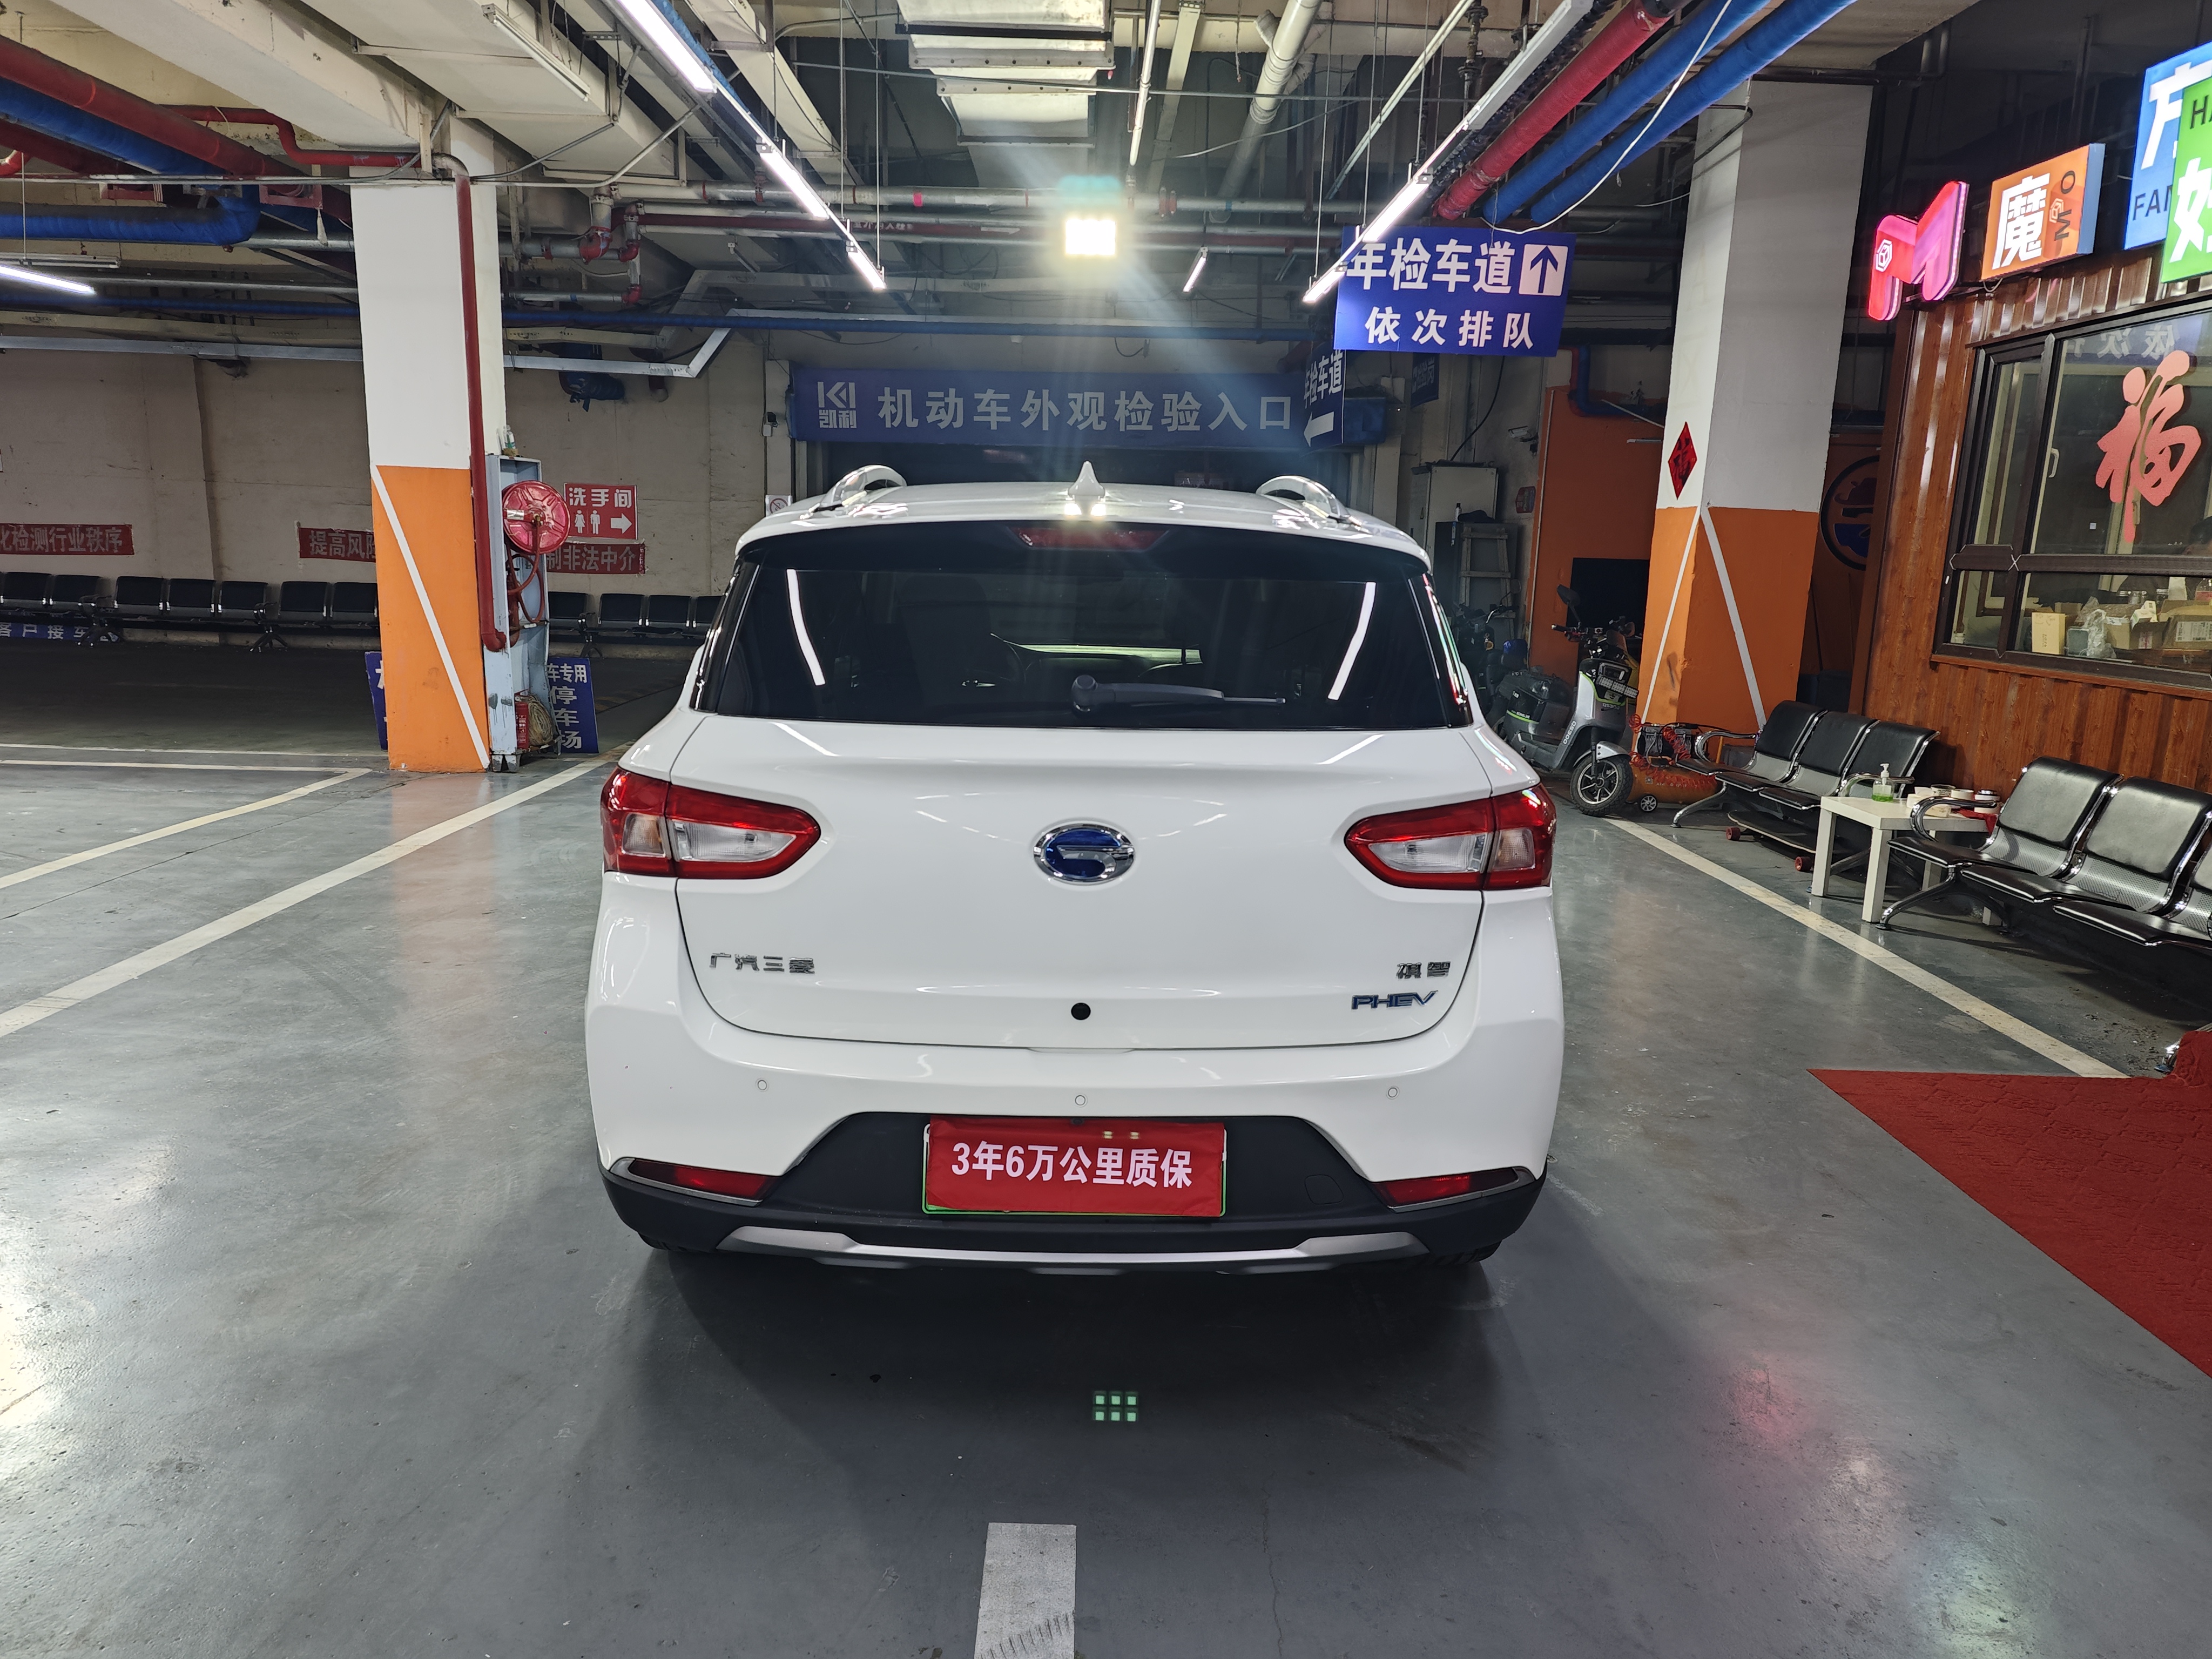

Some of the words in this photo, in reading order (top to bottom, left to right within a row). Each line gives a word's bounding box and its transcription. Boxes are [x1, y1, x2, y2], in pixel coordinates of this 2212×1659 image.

[2190, 94, 2212, 129] H
[1992, 173, 2051, 270] 魔
[1346, 237, 1515, 294] 年检车道
[1365, 306, 1534, 350] 依次排队
[819, 409, 857, 428] 凯利
[878, 387, 1291, 433] 机动车外观检验入口
[2096, 350, 2201, 543] 福
[569, 487, 632, 508] 洗手间
[545, 663, 588, 683] 车专用
[1351, 990, 1439, 1010] PHEV
[951, 1141, 1192, 1189] 3年6万公里质保
